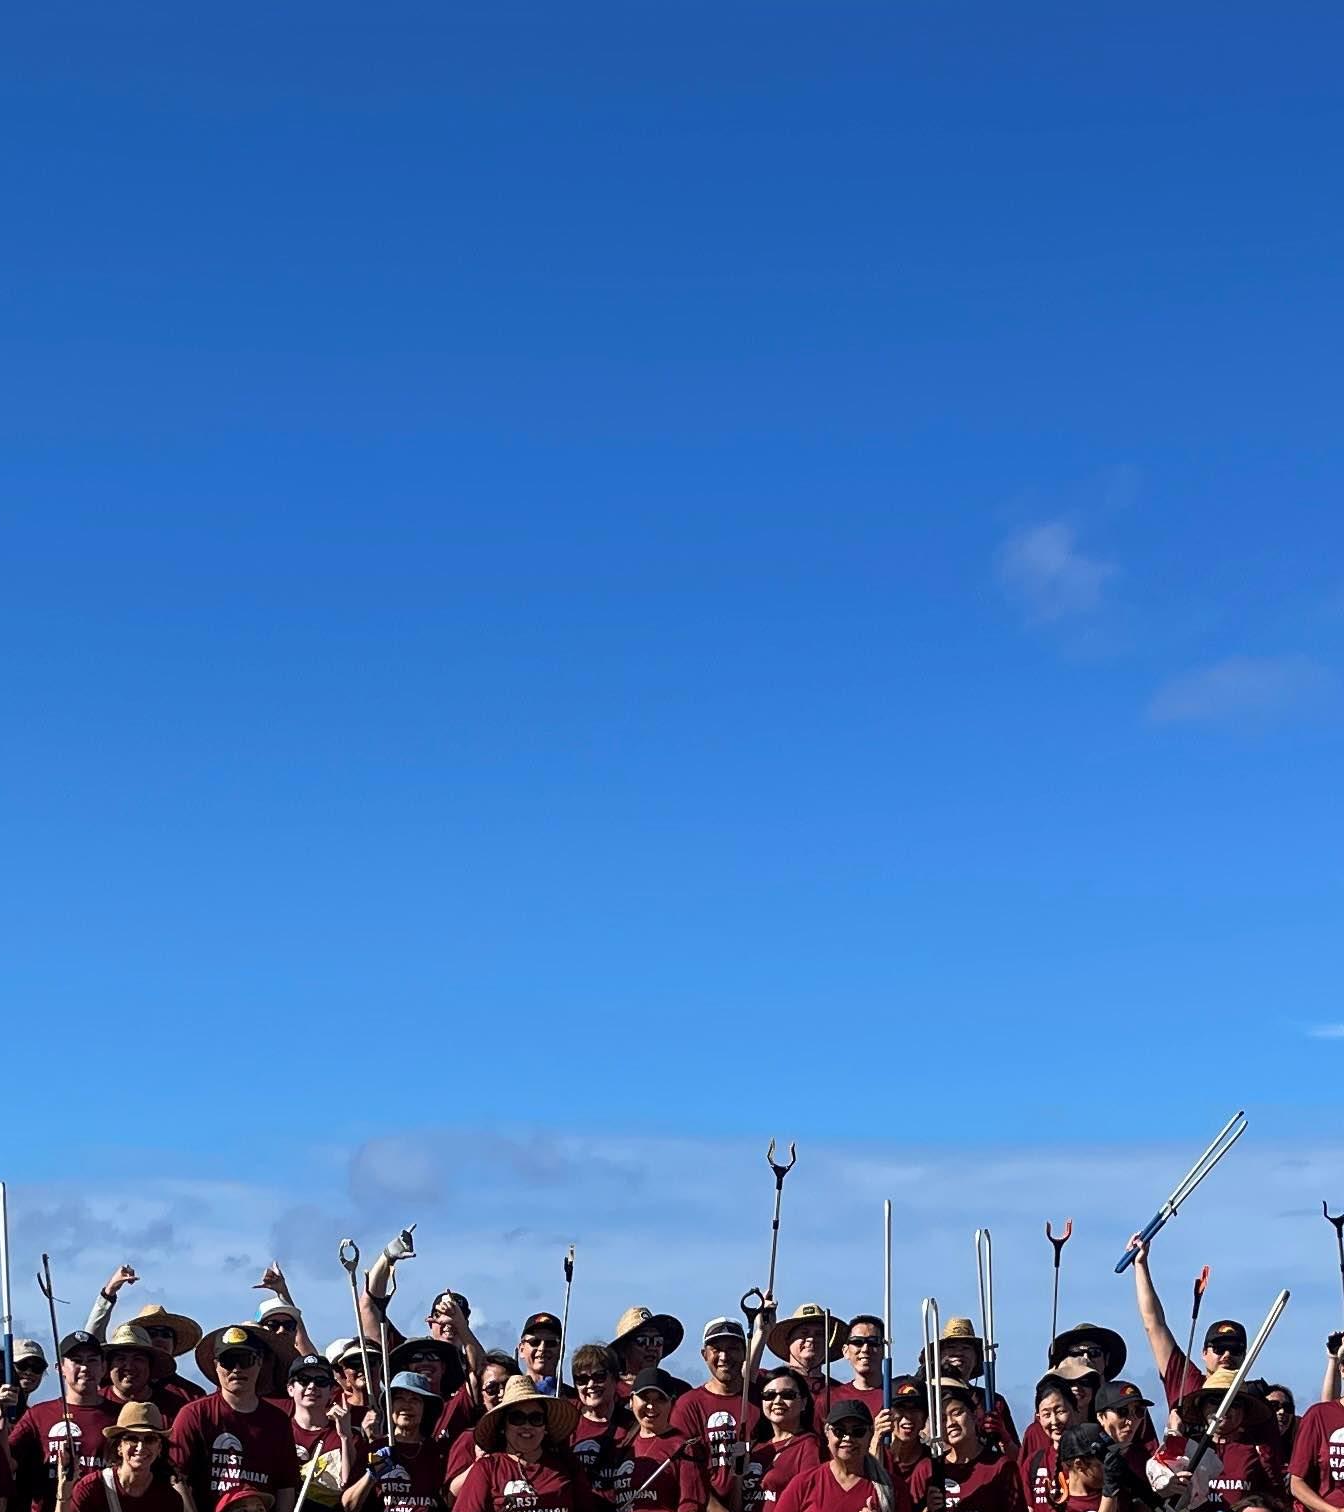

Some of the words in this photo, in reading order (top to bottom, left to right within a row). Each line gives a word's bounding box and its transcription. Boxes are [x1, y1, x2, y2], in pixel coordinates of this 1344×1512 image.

[212, 1453, 244, 1465] FIRST
[211, 1466, 269, 1484] HAWAIIAN
[382, 1481, 411, 1493] FIRST
